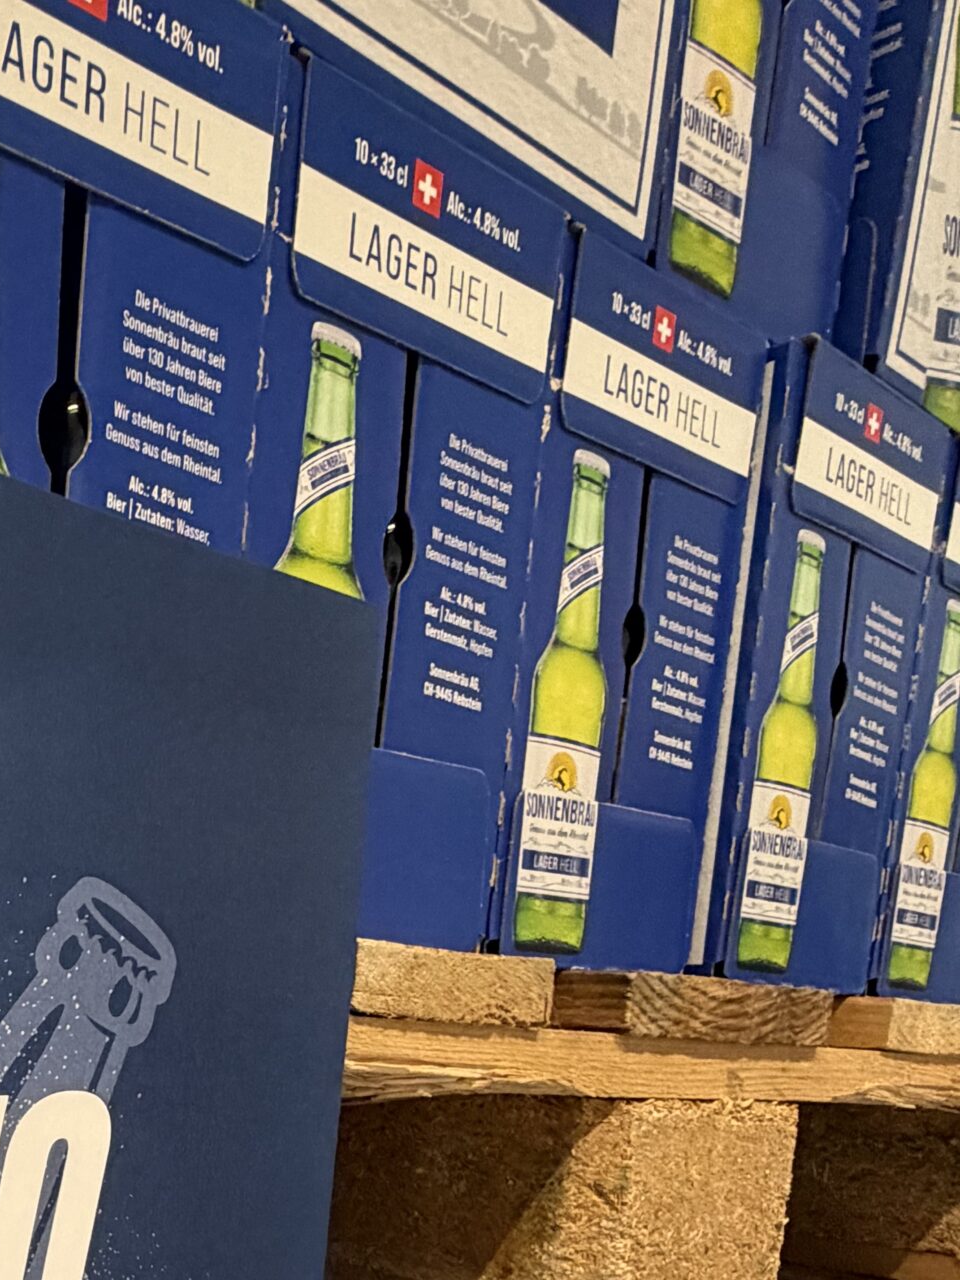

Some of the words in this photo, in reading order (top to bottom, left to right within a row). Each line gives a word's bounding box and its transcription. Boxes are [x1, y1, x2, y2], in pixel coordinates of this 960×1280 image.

[117, 0, 152, 33] Alc.:
[155, 13, 194, 57] 4.8%
[198, 42, 224, 74] vol.
[124, 81, 210, 176] HELL
[355, 137, 368, 164] 10
[380, 152, 396, 180] 33
[397, 165, 408, 188] cl
[447, 191, 472, 224] Alc.:
[473, 207, 500, 240] 4.8%
[503, 229, 521, 252] vol.
[349, 212, 438, 301] LAGER
[448, 265, 508, 337] HELL
[123, 310, 179, 350] Sonnenbräu
[182, 337, 206, 361] braut
[208, 352, 225, 371] seit
[135, 289, 151, 309] Die
[152, 298, 219, 342] Privatbrauerei
[612, 292, 623, 314] 10
[629, 302, 642, 325] 33
[642, 311, 651, 330] cl
[697, 341, 717, 367] 4.8%
[719, 357, 733, 377] vol.
[123, 337, 145, 360] über
[148, 347, 163, 368] 130
[166, 356, 196, 383] Jahren
[198, 371, 221, 393] Biere
[126, 367, 142, 384] von
[145, 372, 174, 399] bester
[177, 386, 215, 415] Qualität.
[114, 401, 130, 421] Wir
[132, 409, 164, 436] stehen
[166, 423, 181, 442] für
[182, 431, 219, 458] feinsten
[604, 355, 670, 422] LAGER
[676, 392, 721, 448] HELL
[105, 424, 140, 451] Genuss
[142, 442, 159, 459] aus
[161, 447, 181, 467] dem
[183, 455, 222, 484] Rheintal.
[107, 492, 127, 514] Bier
[135, 503, 175, 531] Zutaten:
[129, 476, 150, 498] Alc.:
[151, 484, 175, 505] 4.8%
[177, 498, 194, 514] vol.
[825, 447, 876, 504] LAGER
[878, 477, 911, 526] HELL
[533, 853, 558, 870] LAGER
